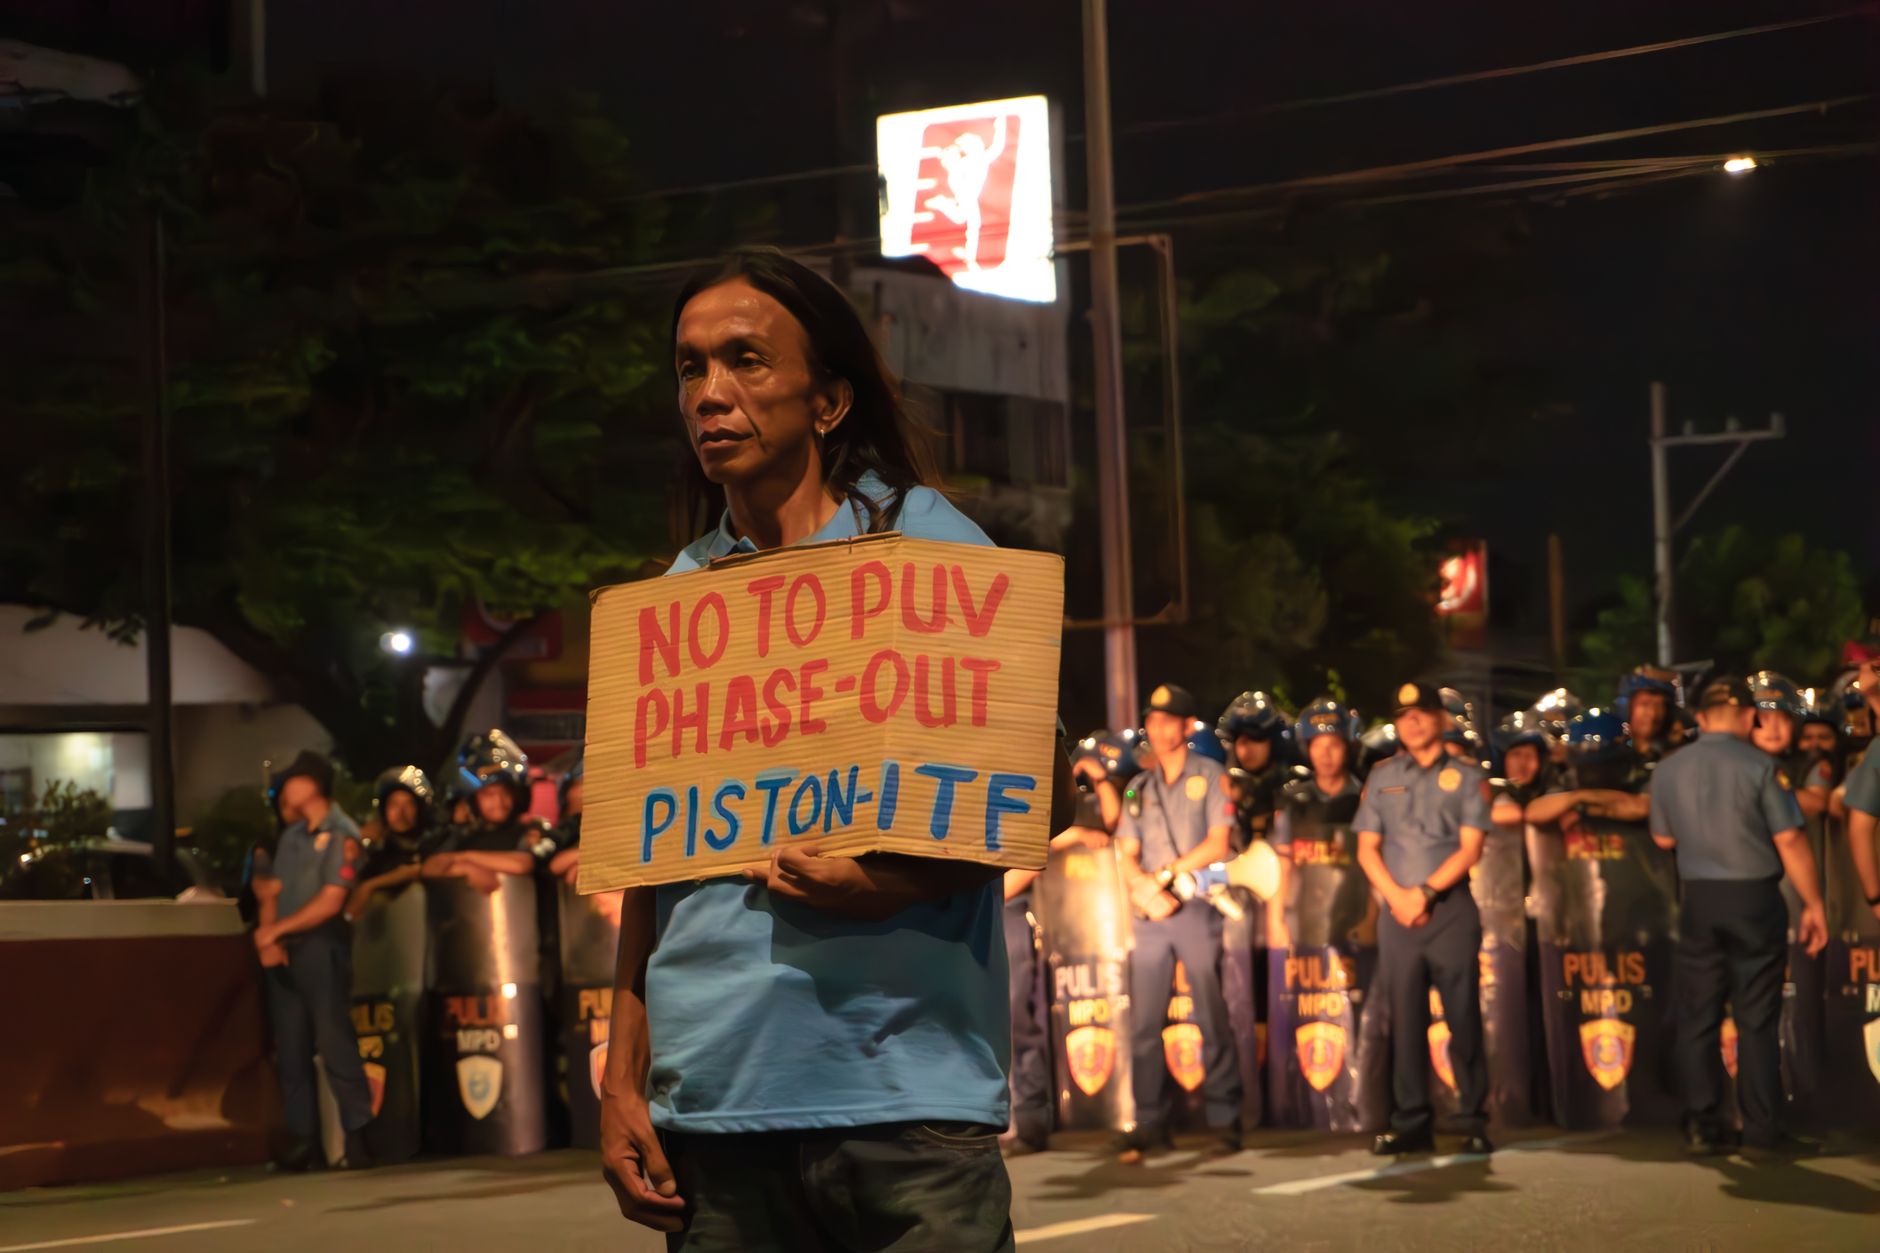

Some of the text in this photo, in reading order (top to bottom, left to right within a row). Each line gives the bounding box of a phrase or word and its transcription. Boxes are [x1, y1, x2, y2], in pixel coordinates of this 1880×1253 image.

[637, 560, 1010, 687] NO TO PUV
[633, 649, 1002, 769] PHASE-OUT
[640, 759, 1038, 865] PISTON-ITF
[1298, 992, 1345, 1017] MPD
[1562, 951, 1646, 988] PULIS
[1581, 989, 1633, 1014] MPD
